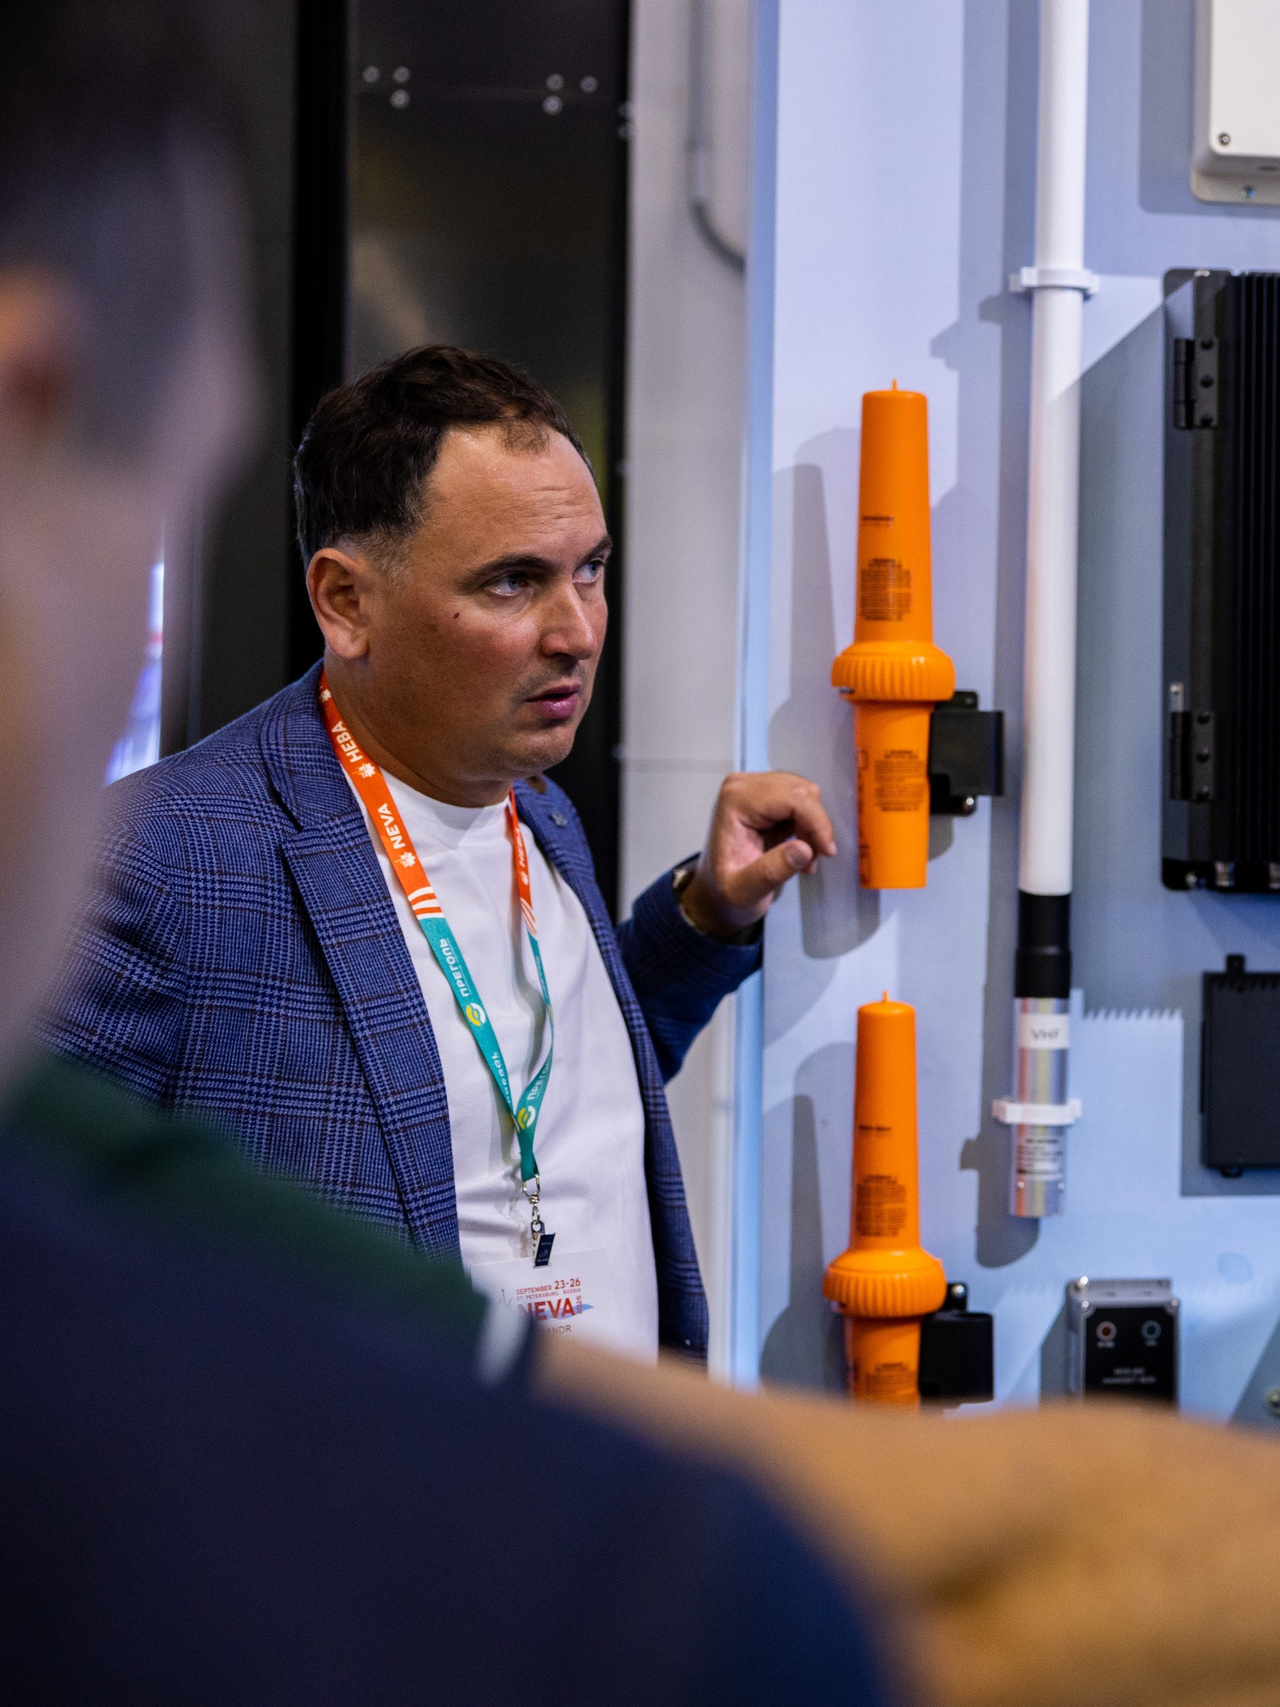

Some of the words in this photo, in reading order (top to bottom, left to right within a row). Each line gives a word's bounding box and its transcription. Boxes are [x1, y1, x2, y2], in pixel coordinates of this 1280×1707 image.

[378, 803, 406, 849] NEVA
[439, 938, 470, 998] ПРЕГОЛЬ
[516, 1285, 552, 1295] SEPTEMBER
[554, 1277, 581, 1290] 23-26
[518, 1298, 576, 1320] NEVA
